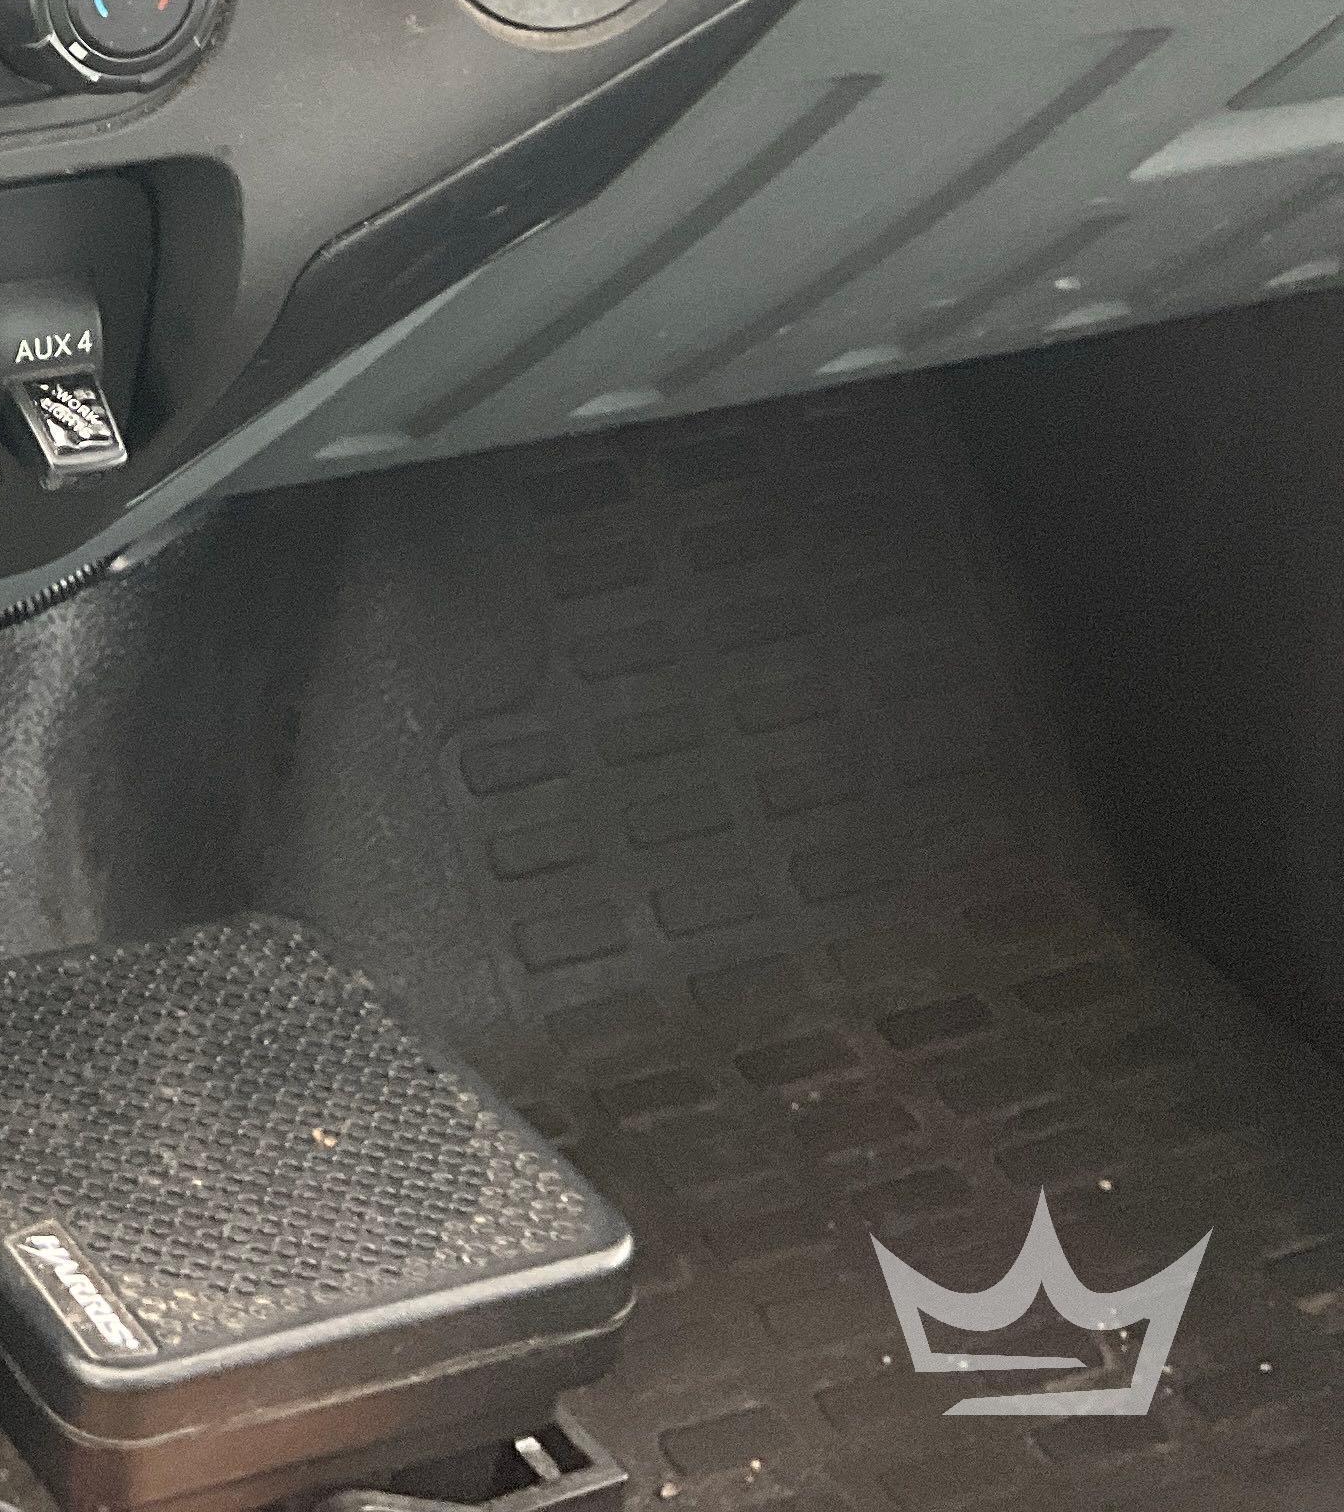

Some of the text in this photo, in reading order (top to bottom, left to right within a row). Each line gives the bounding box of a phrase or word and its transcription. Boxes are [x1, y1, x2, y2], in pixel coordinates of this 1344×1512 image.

[14, 328, 94, 364] AUX 4
[55, 383, 103, 426] WORK
